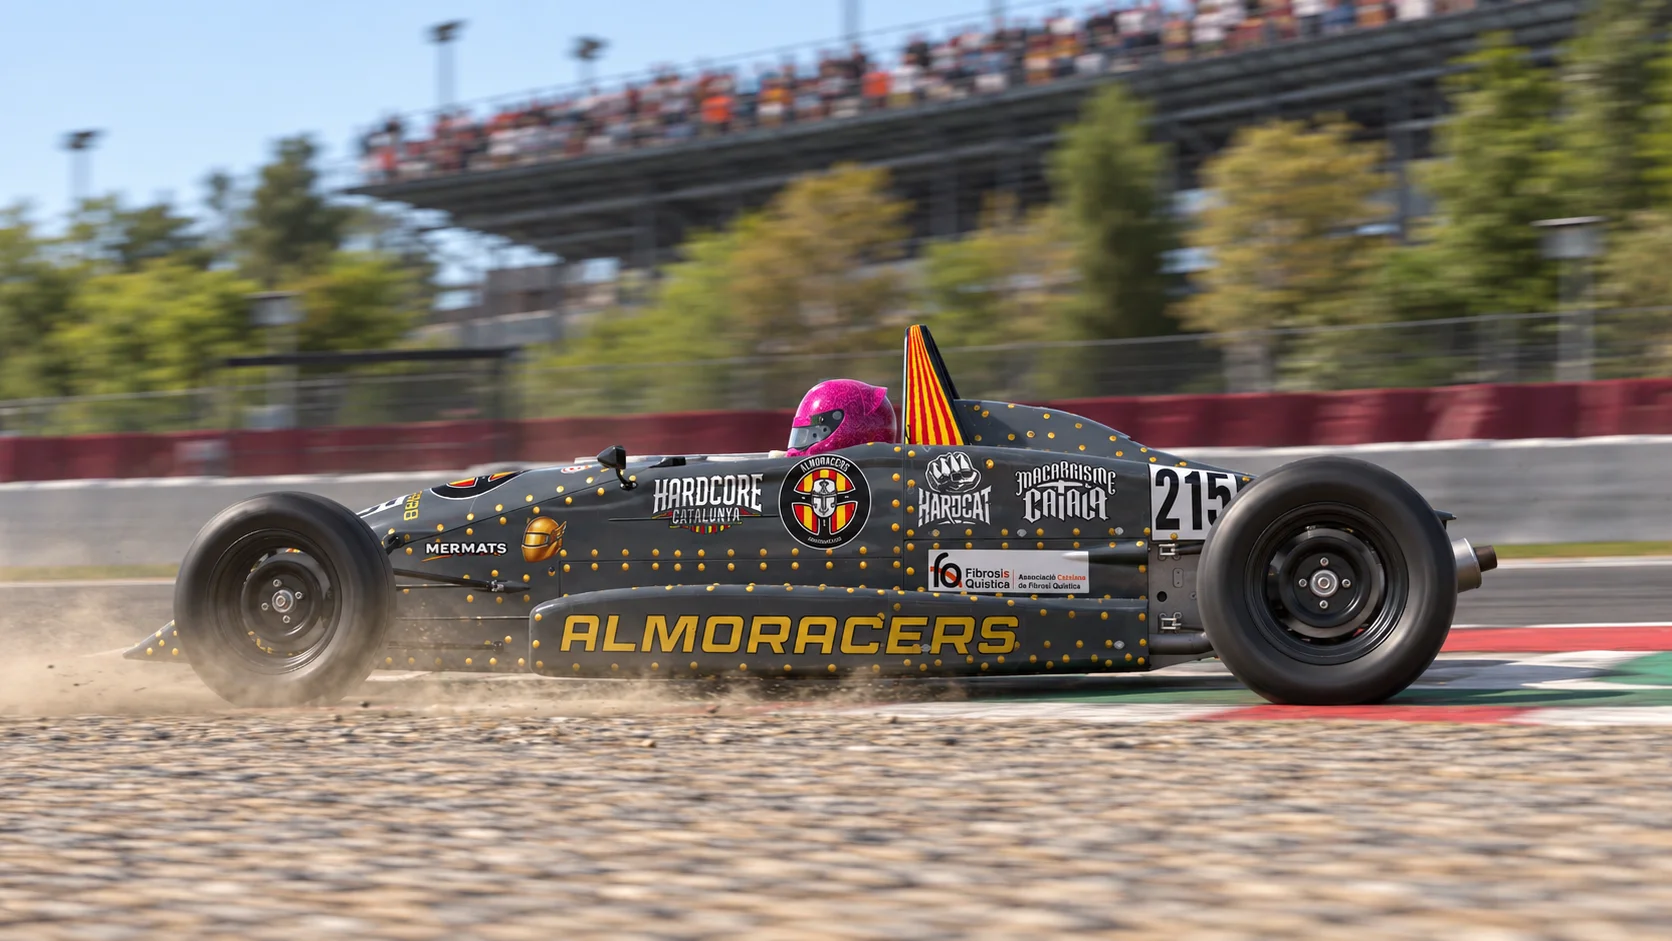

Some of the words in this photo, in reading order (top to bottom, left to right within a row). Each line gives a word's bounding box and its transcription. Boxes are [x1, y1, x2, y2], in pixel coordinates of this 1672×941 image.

[653, 473, 764, 514] HARDCORE
[918, 485, 992, 528] HARDCAT
[1155, 468, 1231, 531] 215
[672, 507, 741, 524] CATALUNYA
[426, 542, 507, 555] MERMATS
[965, 568, 1010, 578] Fibrosis
[560, 614, 1020, 656] ALMORACERS
